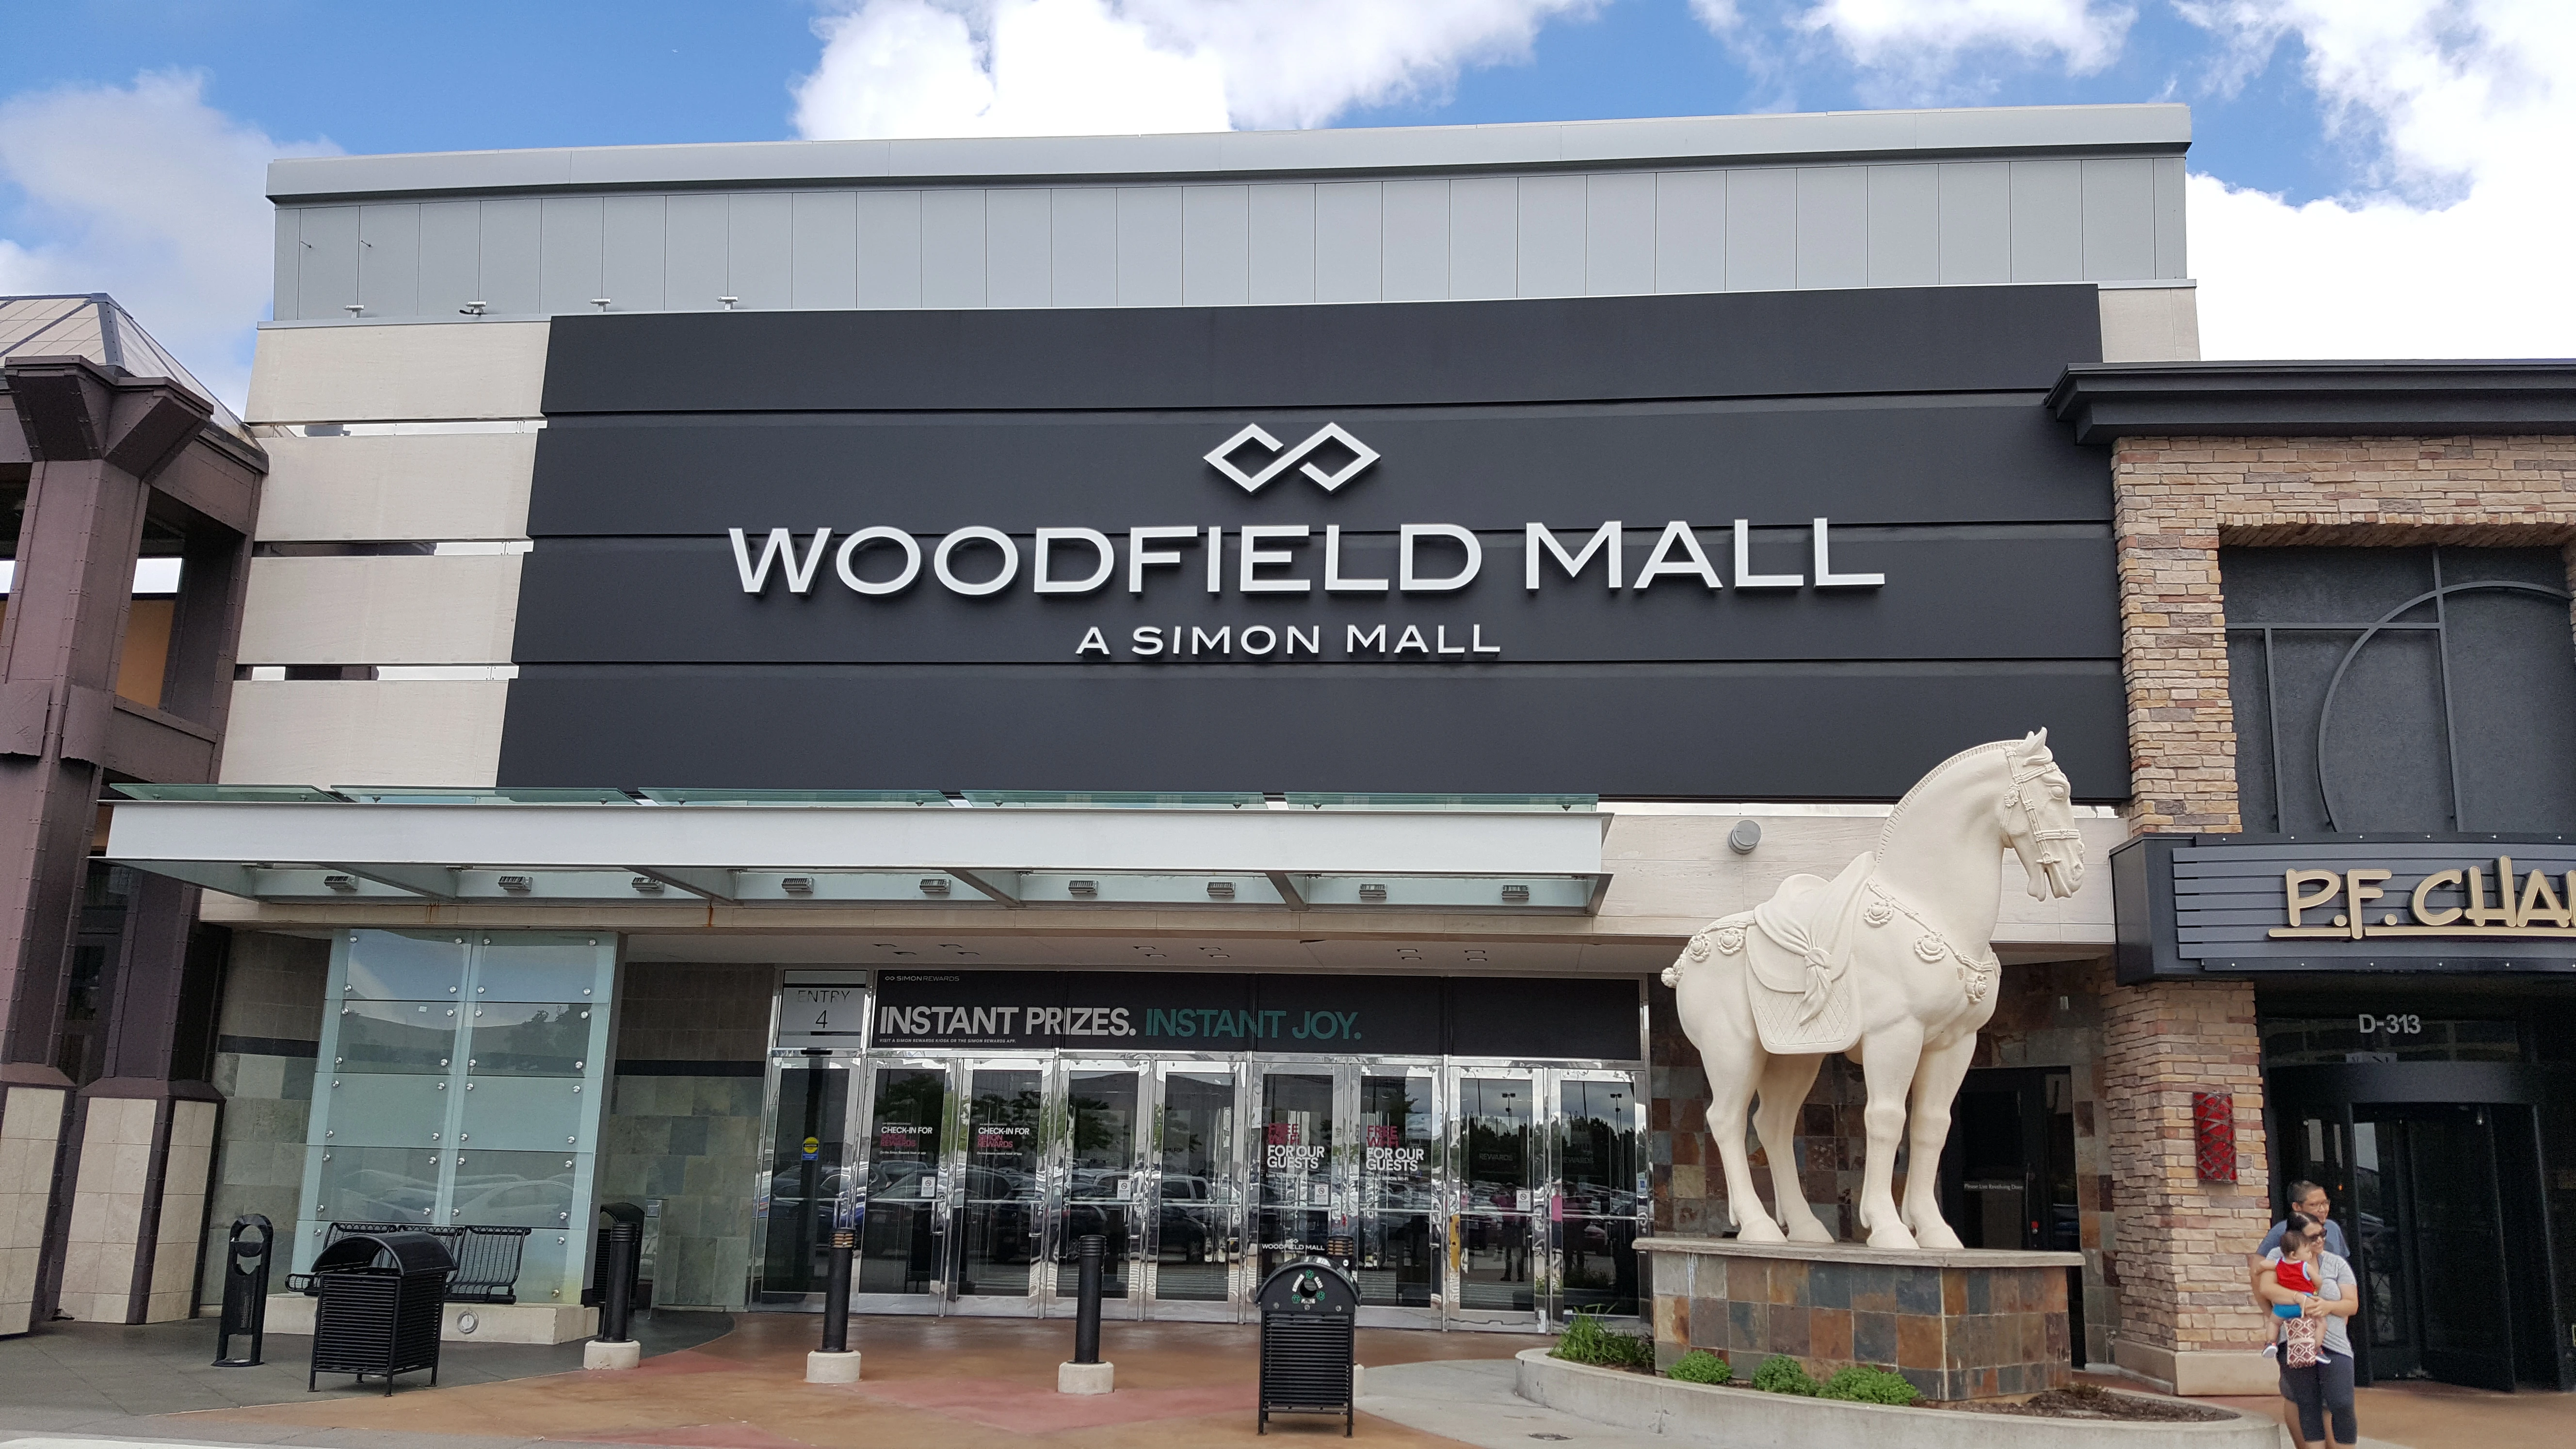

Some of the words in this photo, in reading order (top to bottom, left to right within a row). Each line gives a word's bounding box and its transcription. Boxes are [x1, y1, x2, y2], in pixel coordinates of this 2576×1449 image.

[728, 524, 1481, 595] WOODFIELD
[1526, 518, 1885, 589] MALL
[1076, 627, 1110, 654] A
[1132, 625, 1319, 654] SIMON
[1347, 624, 1500, 652] MALL
[2286, 868, 2397, 939] P.F.
[2413, 855, 2576, 927] CHA
[798, 990, 850, 1002] ENTRY
[816, 1010, 828, 1028] 4
[880, 1006, 1019, 1034] INSTANT
[1026, 1007, 1136, 1036] PRIZES.
[1145, 1008, 1286, 1038] INSTANT
[1292, 1011, 1361, 1040] JOY.
[2359, 1014, 2421, 1034] D-313
[1368, 1126, 1398, 1136] FREE
[1268, 1145, 1294, 1157] FOR
[1296, 1146, 1325, 1158] OUR
[1367, 1147, 1393, 1159] FOR
[1395, 1148, 1424, 1160] OUR
[1267, 1156, 1319, 1169] GUESTS
[1366, 1159, 1418, 1172] GUESTS
